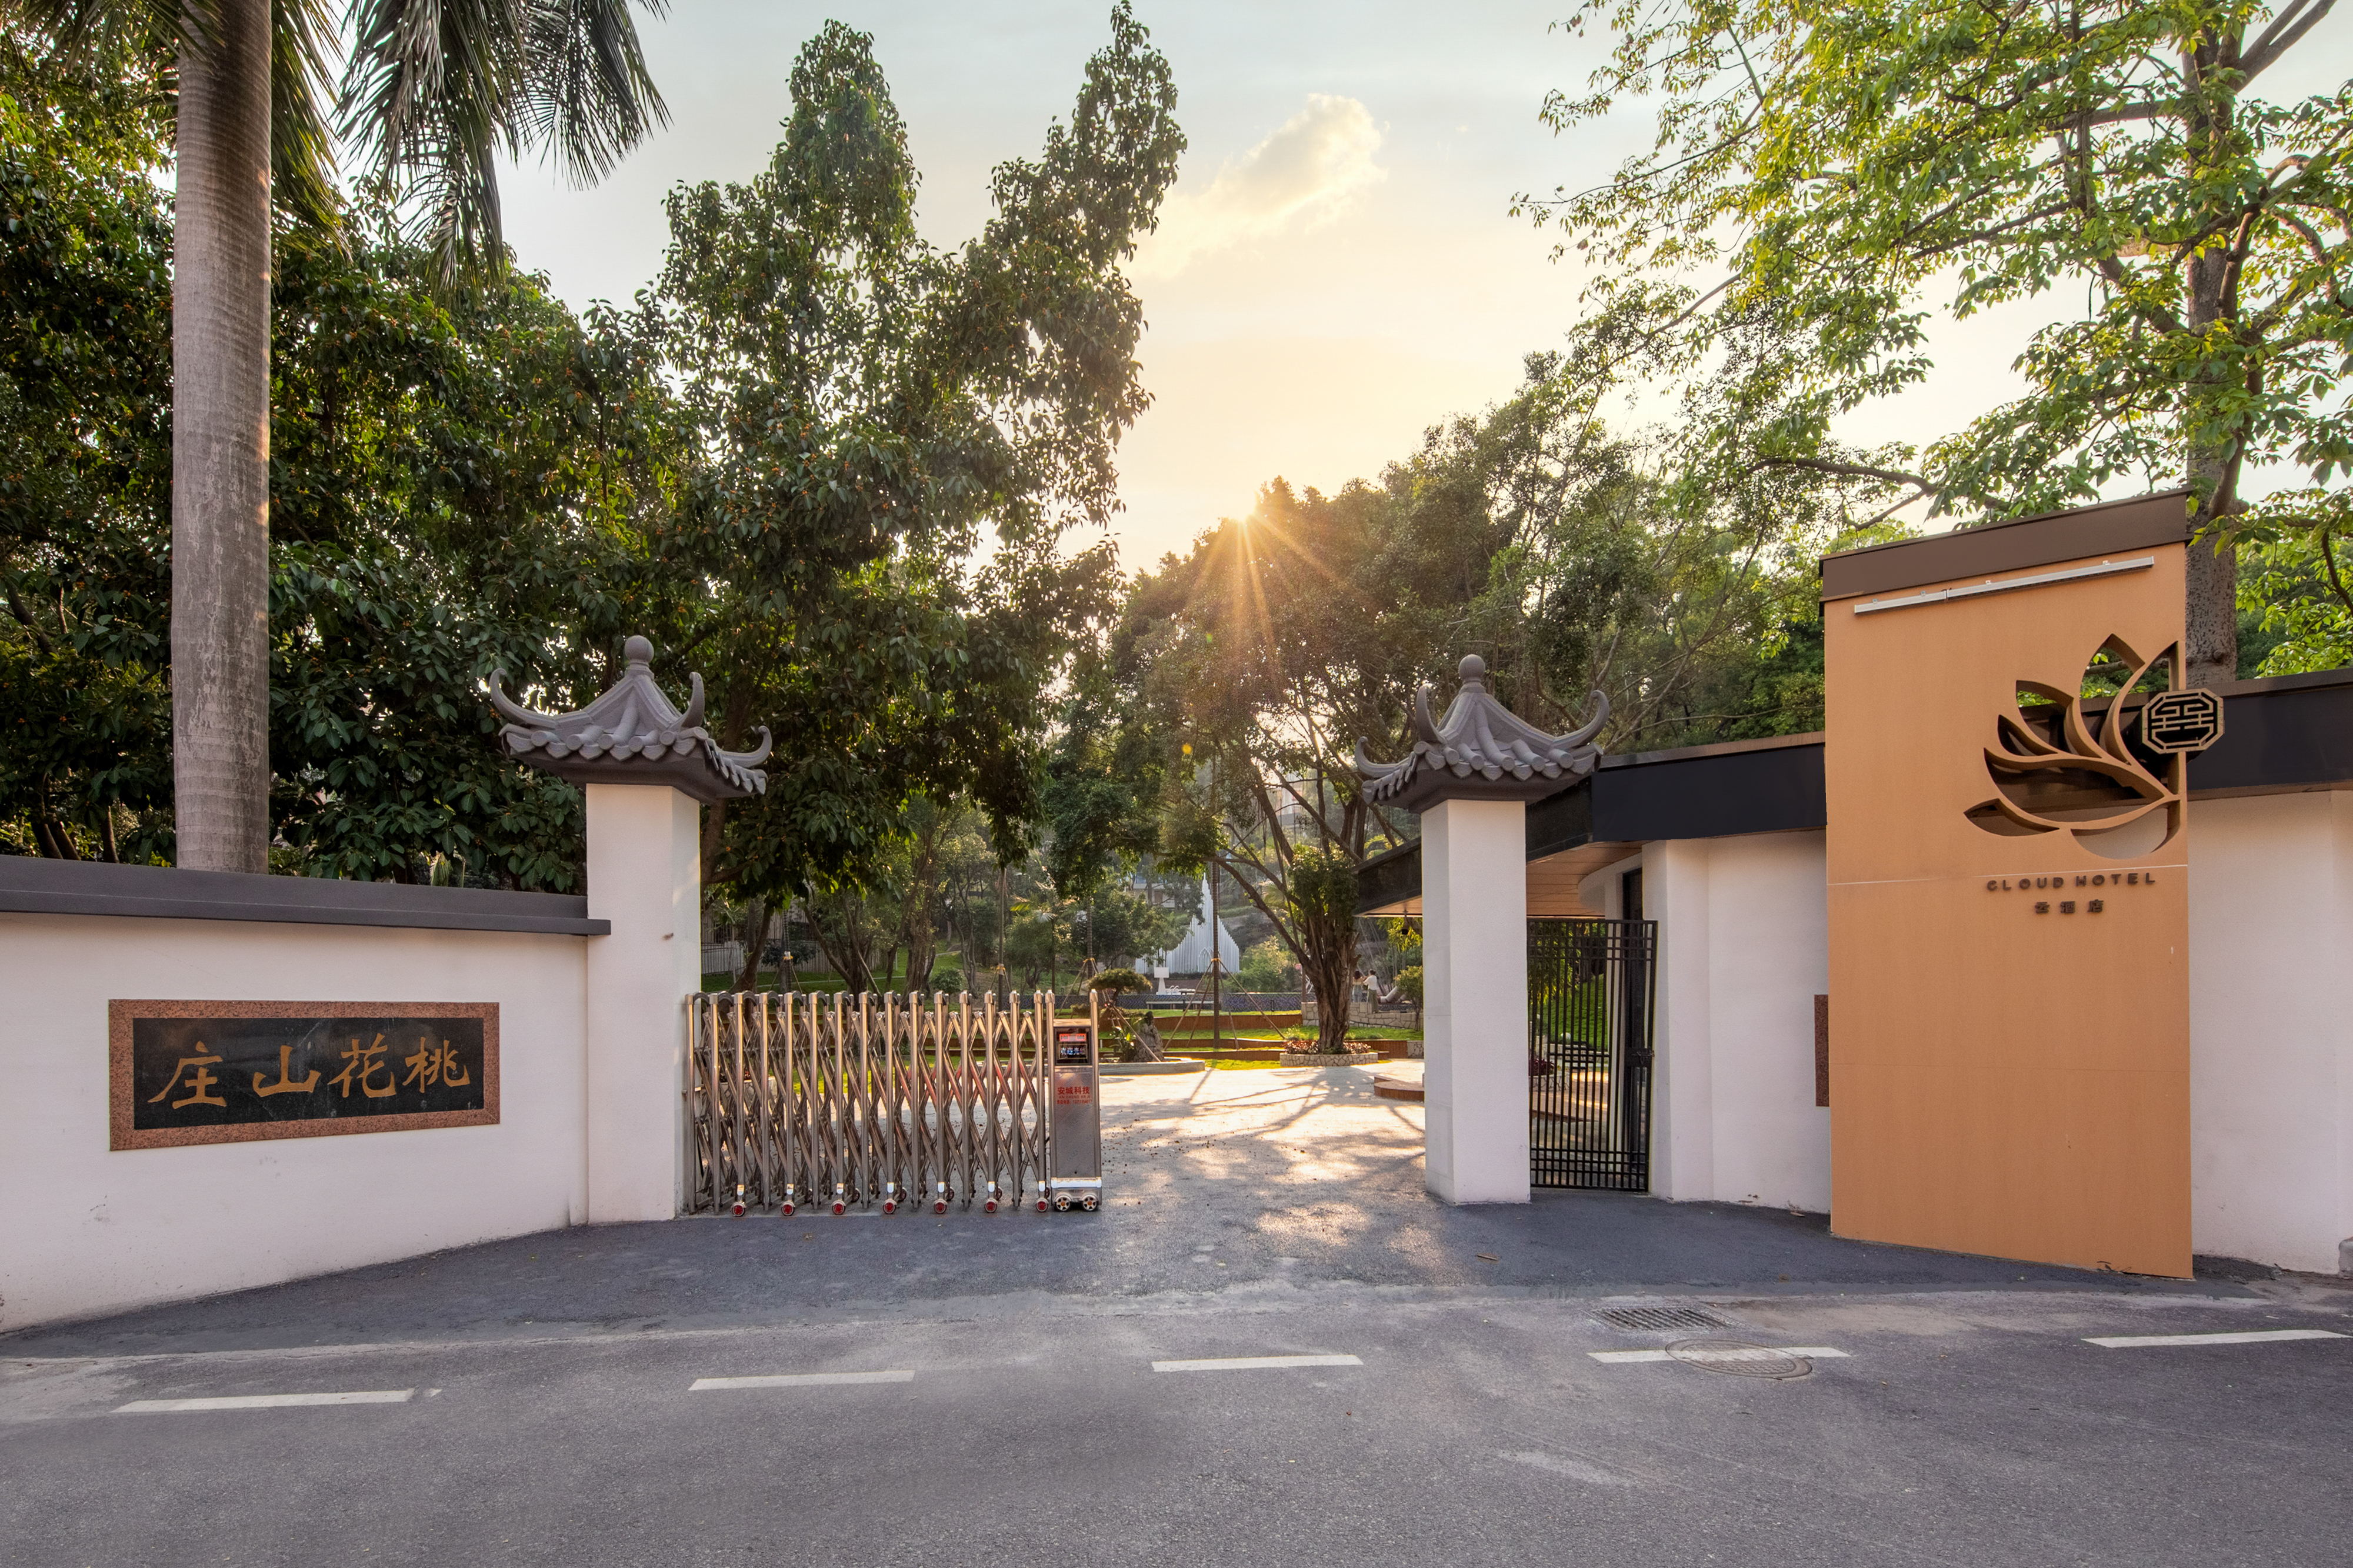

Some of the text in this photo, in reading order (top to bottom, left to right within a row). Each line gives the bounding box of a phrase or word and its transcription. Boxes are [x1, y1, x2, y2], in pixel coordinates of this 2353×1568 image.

[1987, 872, 2156, 891] CLOUD HOTEL
[2034, 899, 2104, 914] 云酒店
[147, 1033, 471, 1109] 桃花山庄
